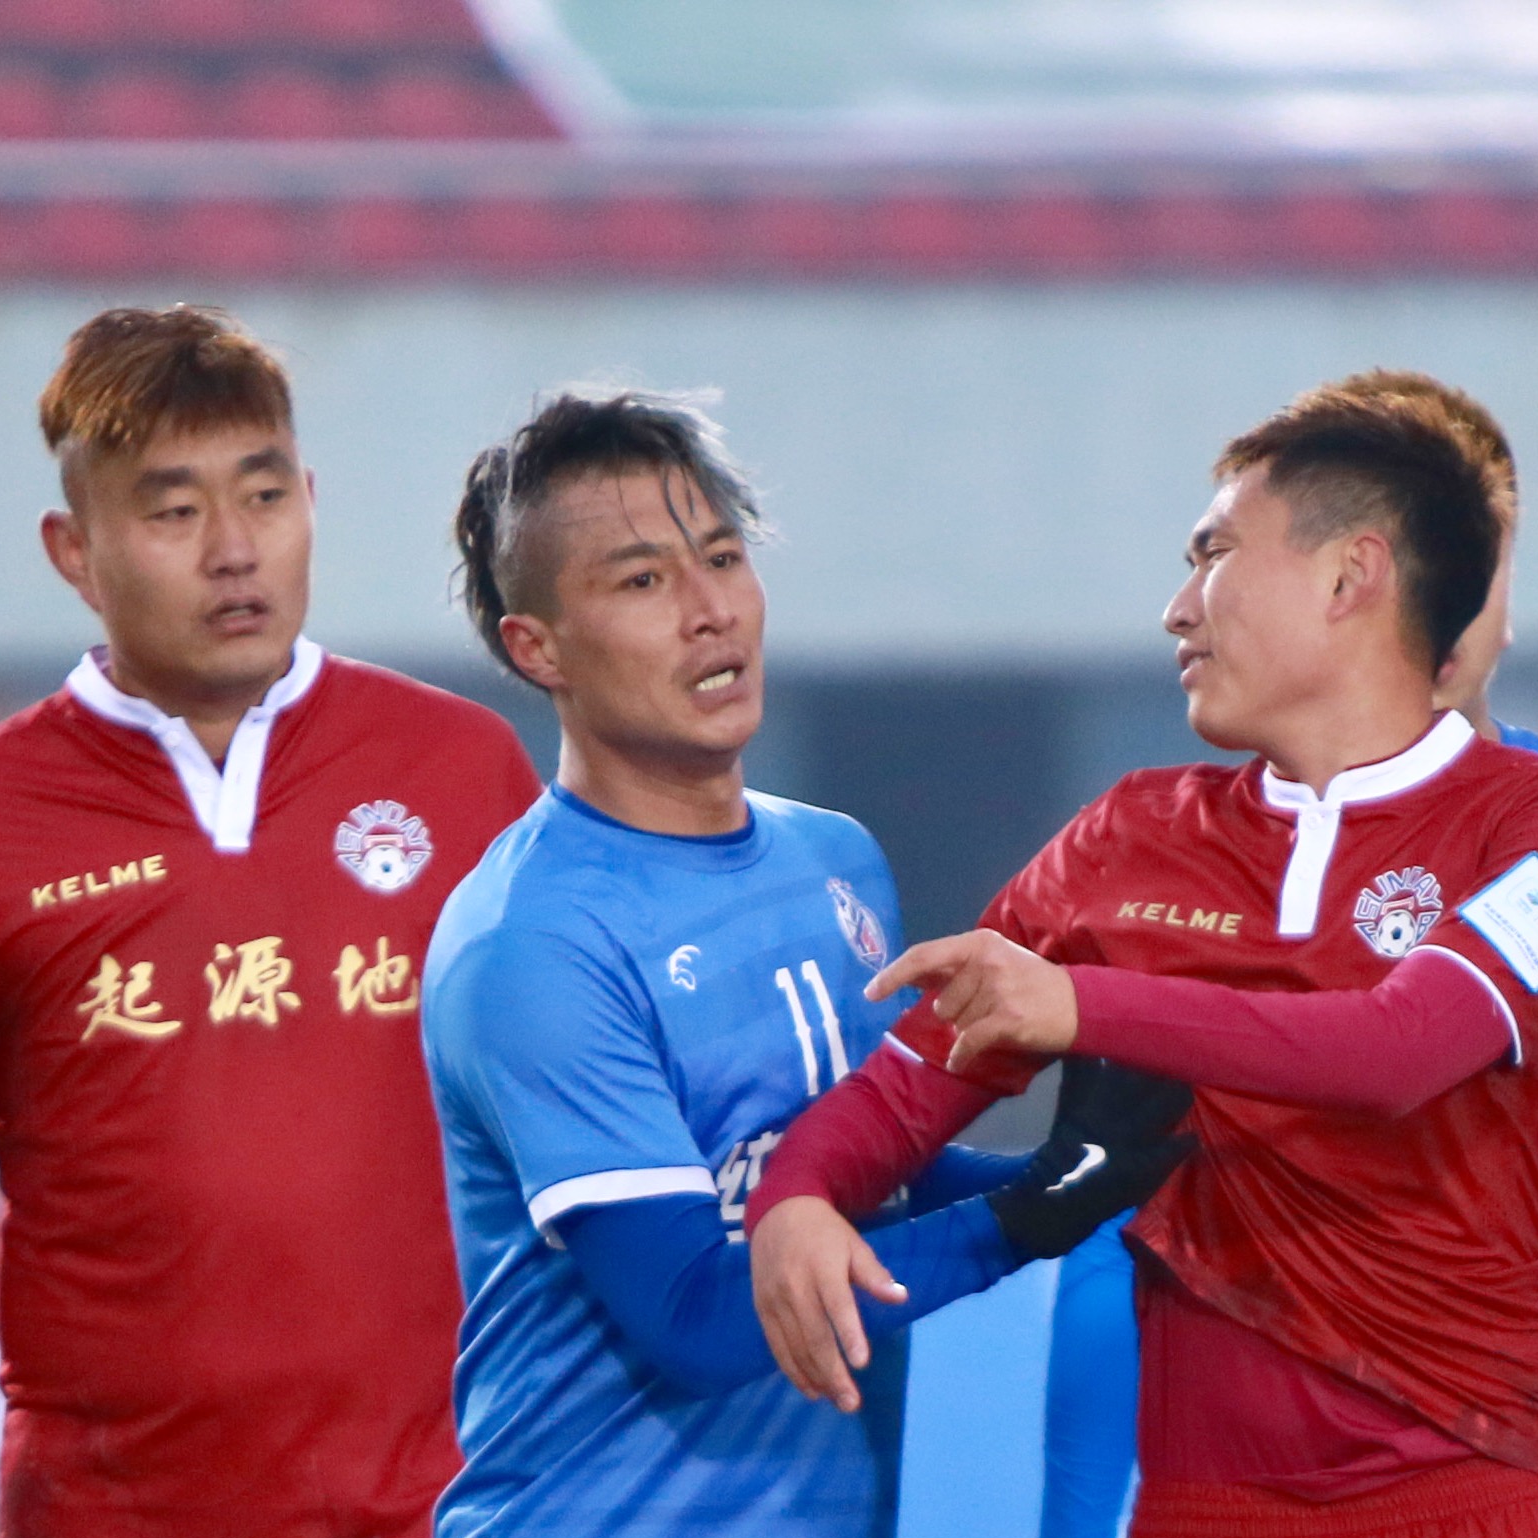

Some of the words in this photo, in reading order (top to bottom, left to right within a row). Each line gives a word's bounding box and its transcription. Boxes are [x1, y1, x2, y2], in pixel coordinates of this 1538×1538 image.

[31, 854, 167, 908] KELME
[1117, 901, 1243, 934] KELME
[75, 936, 418, 1041] 起源地
[775, 959, 850, 1096] 11
